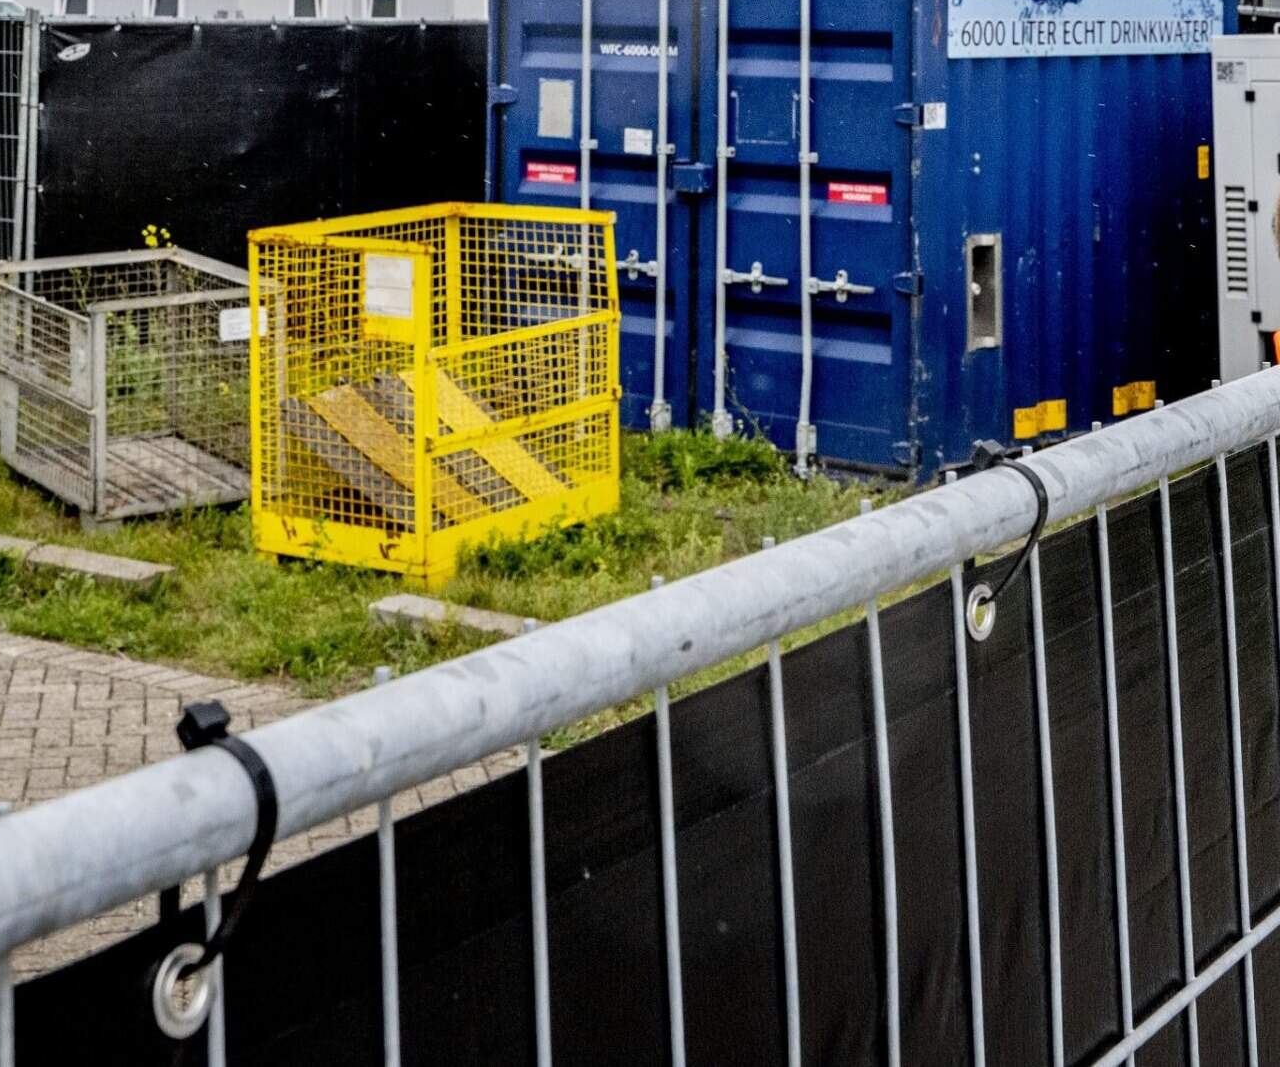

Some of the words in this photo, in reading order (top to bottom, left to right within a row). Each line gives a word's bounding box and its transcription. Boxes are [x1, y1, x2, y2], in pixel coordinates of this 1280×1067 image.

[961, 20, 1007, 47] 6000
[1011, 20, 1057, 46] LITER
[1062, 20, 1105, 46] ECHT
